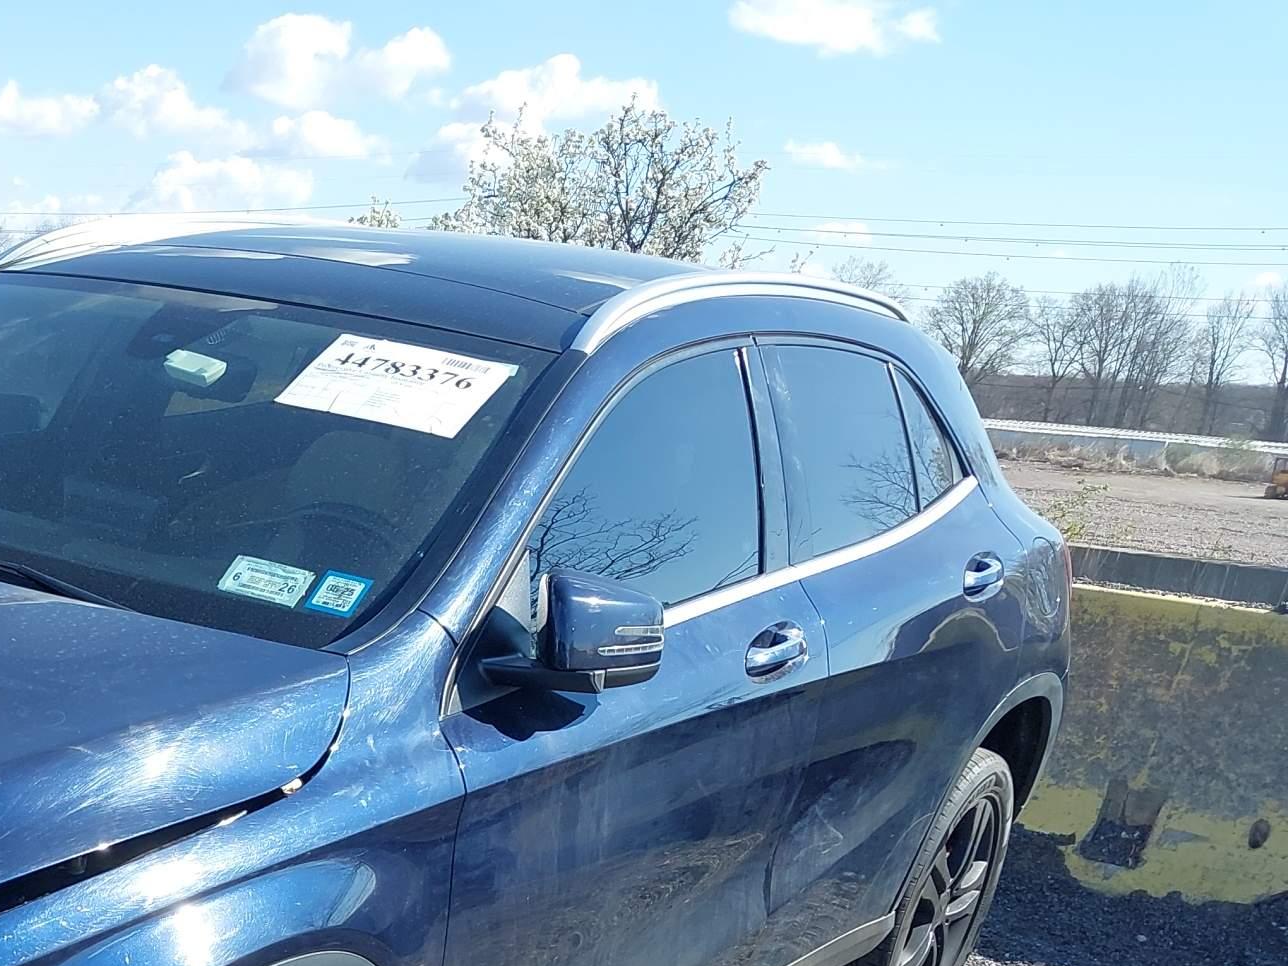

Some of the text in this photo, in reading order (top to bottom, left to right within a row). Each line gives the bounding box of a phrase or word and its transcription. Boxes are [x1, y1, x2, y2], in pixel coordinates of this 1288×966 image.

[334, 352, 474, 391] 44783376
[232, 571, 243, 582] 6
[278, 582, 297, 594] 26
